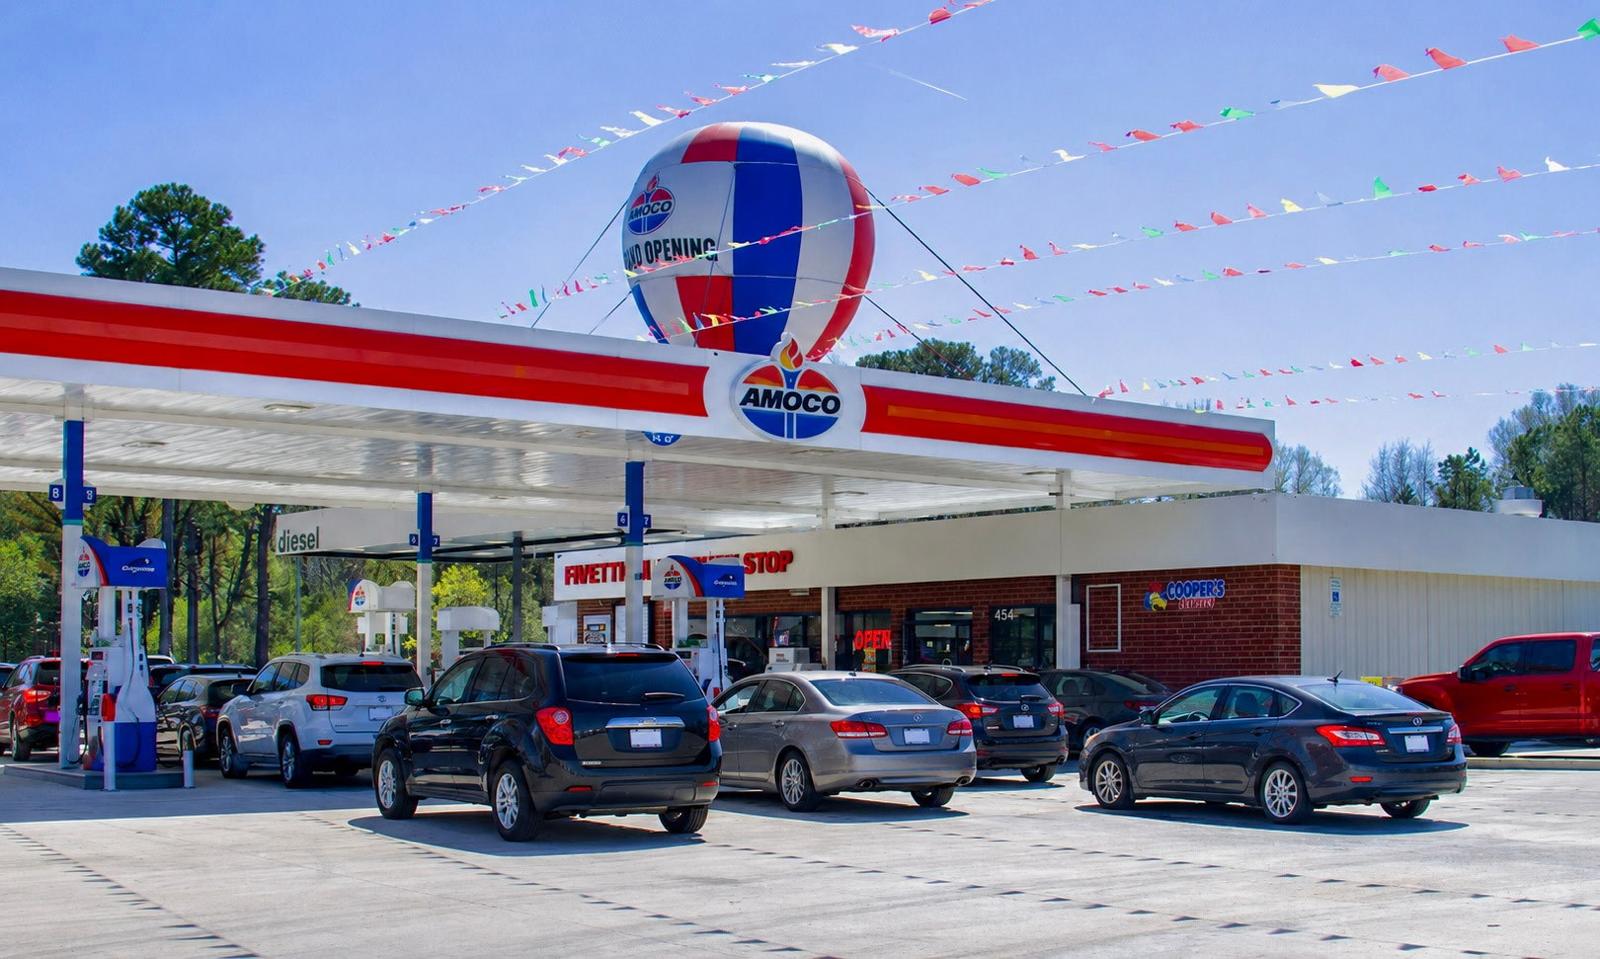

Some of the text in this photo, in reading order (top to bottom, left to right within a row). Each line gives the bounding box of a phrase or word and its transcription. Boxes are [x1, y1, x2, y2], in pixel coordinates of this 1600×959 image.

[628, 201, 672, 221] AMOCO
[645, 238, 718, 265] OPENING
[739, 387, 841, 414] AMOCO
[52, 487, 60, 499] 8
[278, 525, 319, 552] diesel
[743, 550, 794, 575] STOP
[1167, 579, 1225, 600] COOPER'S
[854, 629, 891, 650] OPEN
